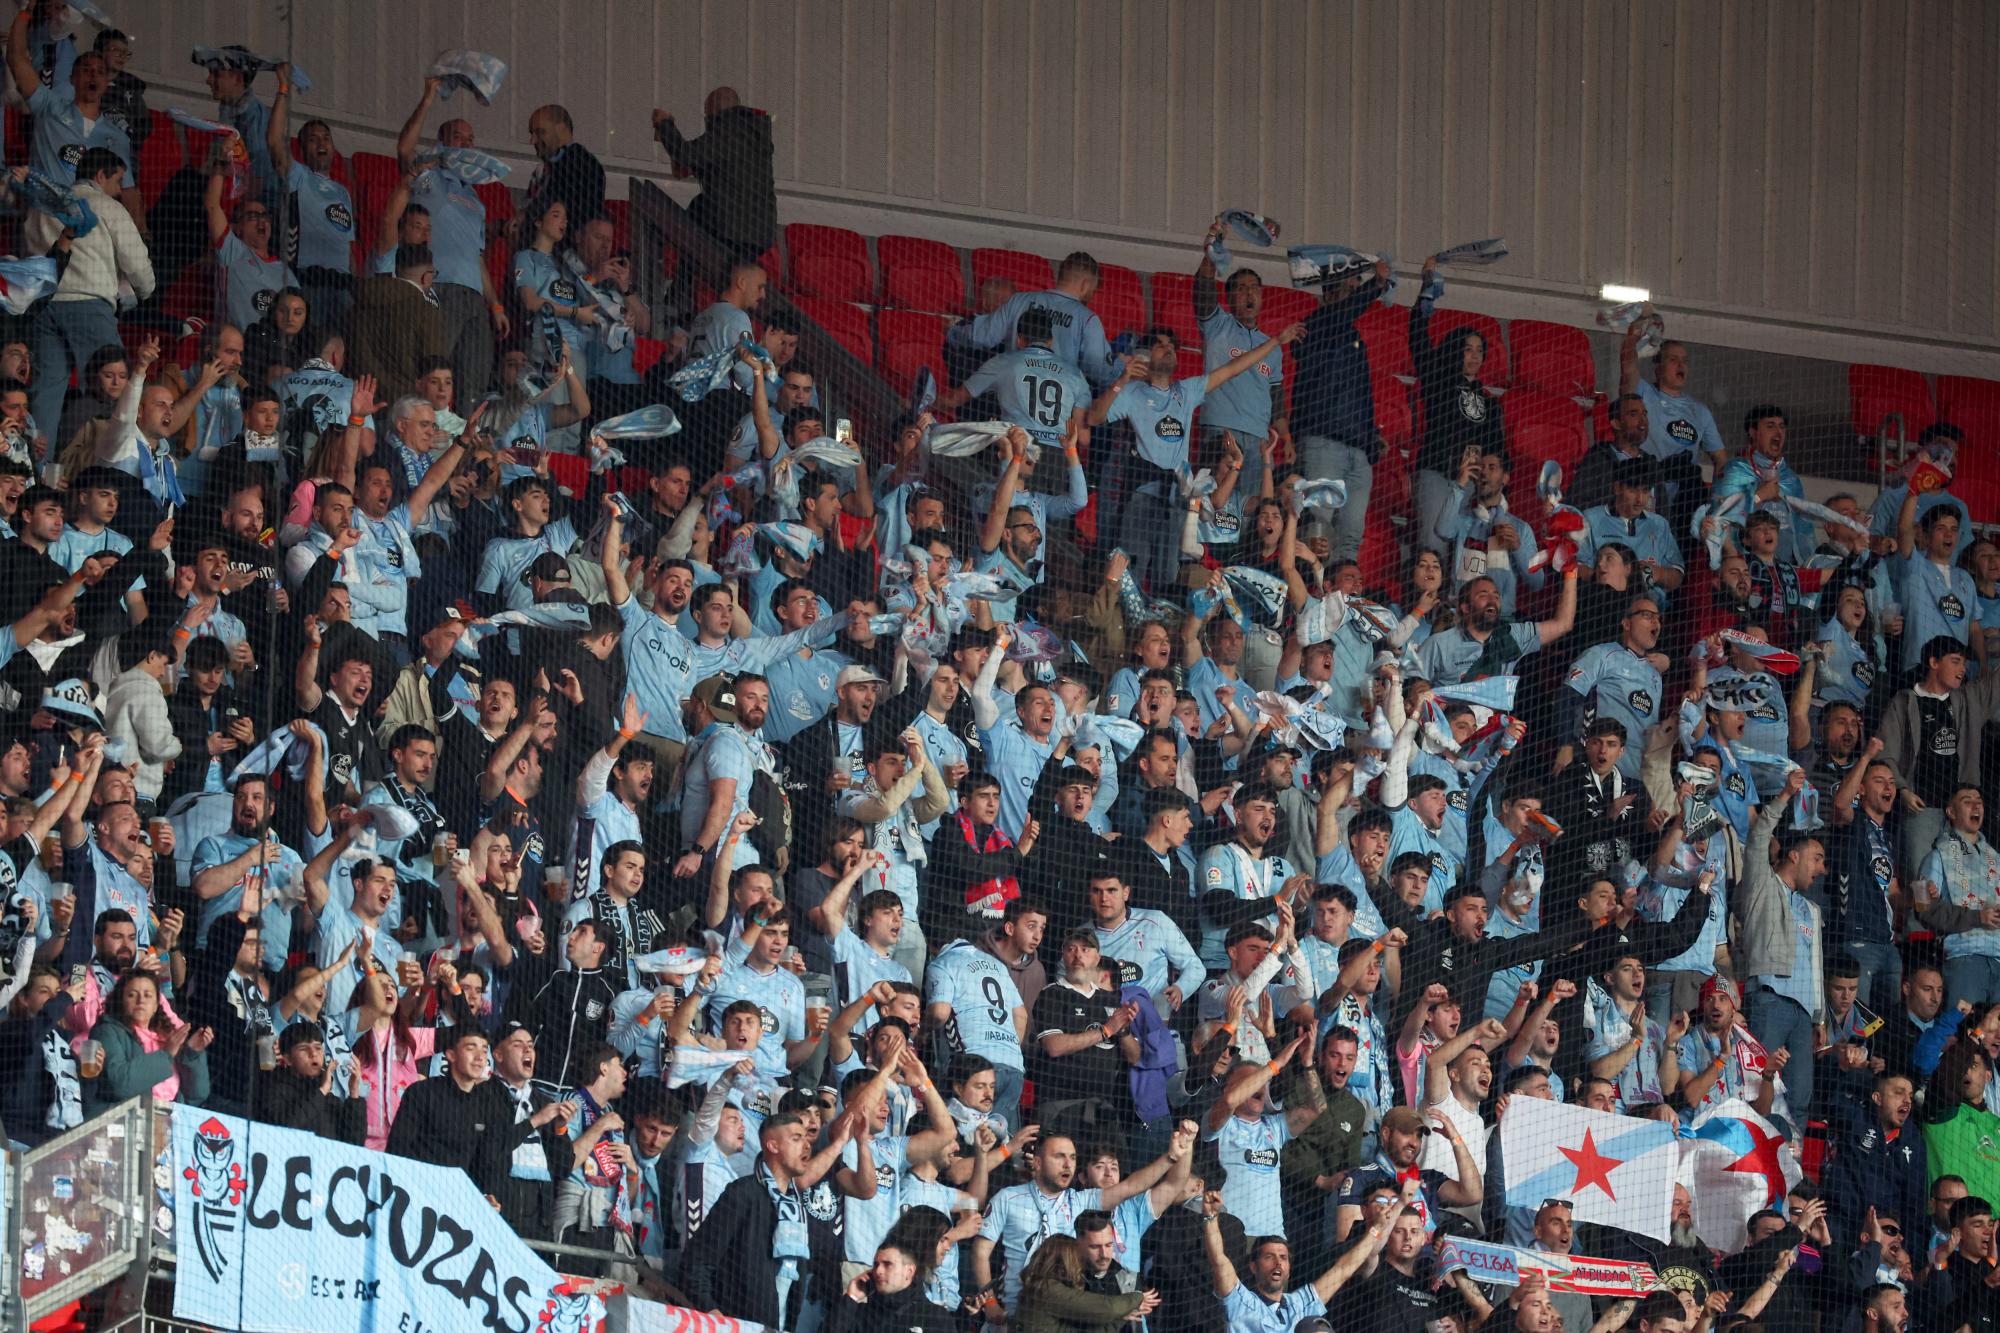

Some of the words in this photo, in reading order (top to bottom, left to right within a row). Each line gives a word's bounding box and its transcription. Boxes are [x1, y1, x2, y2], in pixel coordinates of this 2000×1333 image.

[311, 378, 344, 389] ASPAS
[1023, 375, 1062, 427] 19
[982, 976, 1008, 1025] 9
[1251, 1156, 1273, 1165] Galicia
[246, 1152, 538, 1333] LECHUZAS
[1457, 1249, 1513, 1274] CELTA
